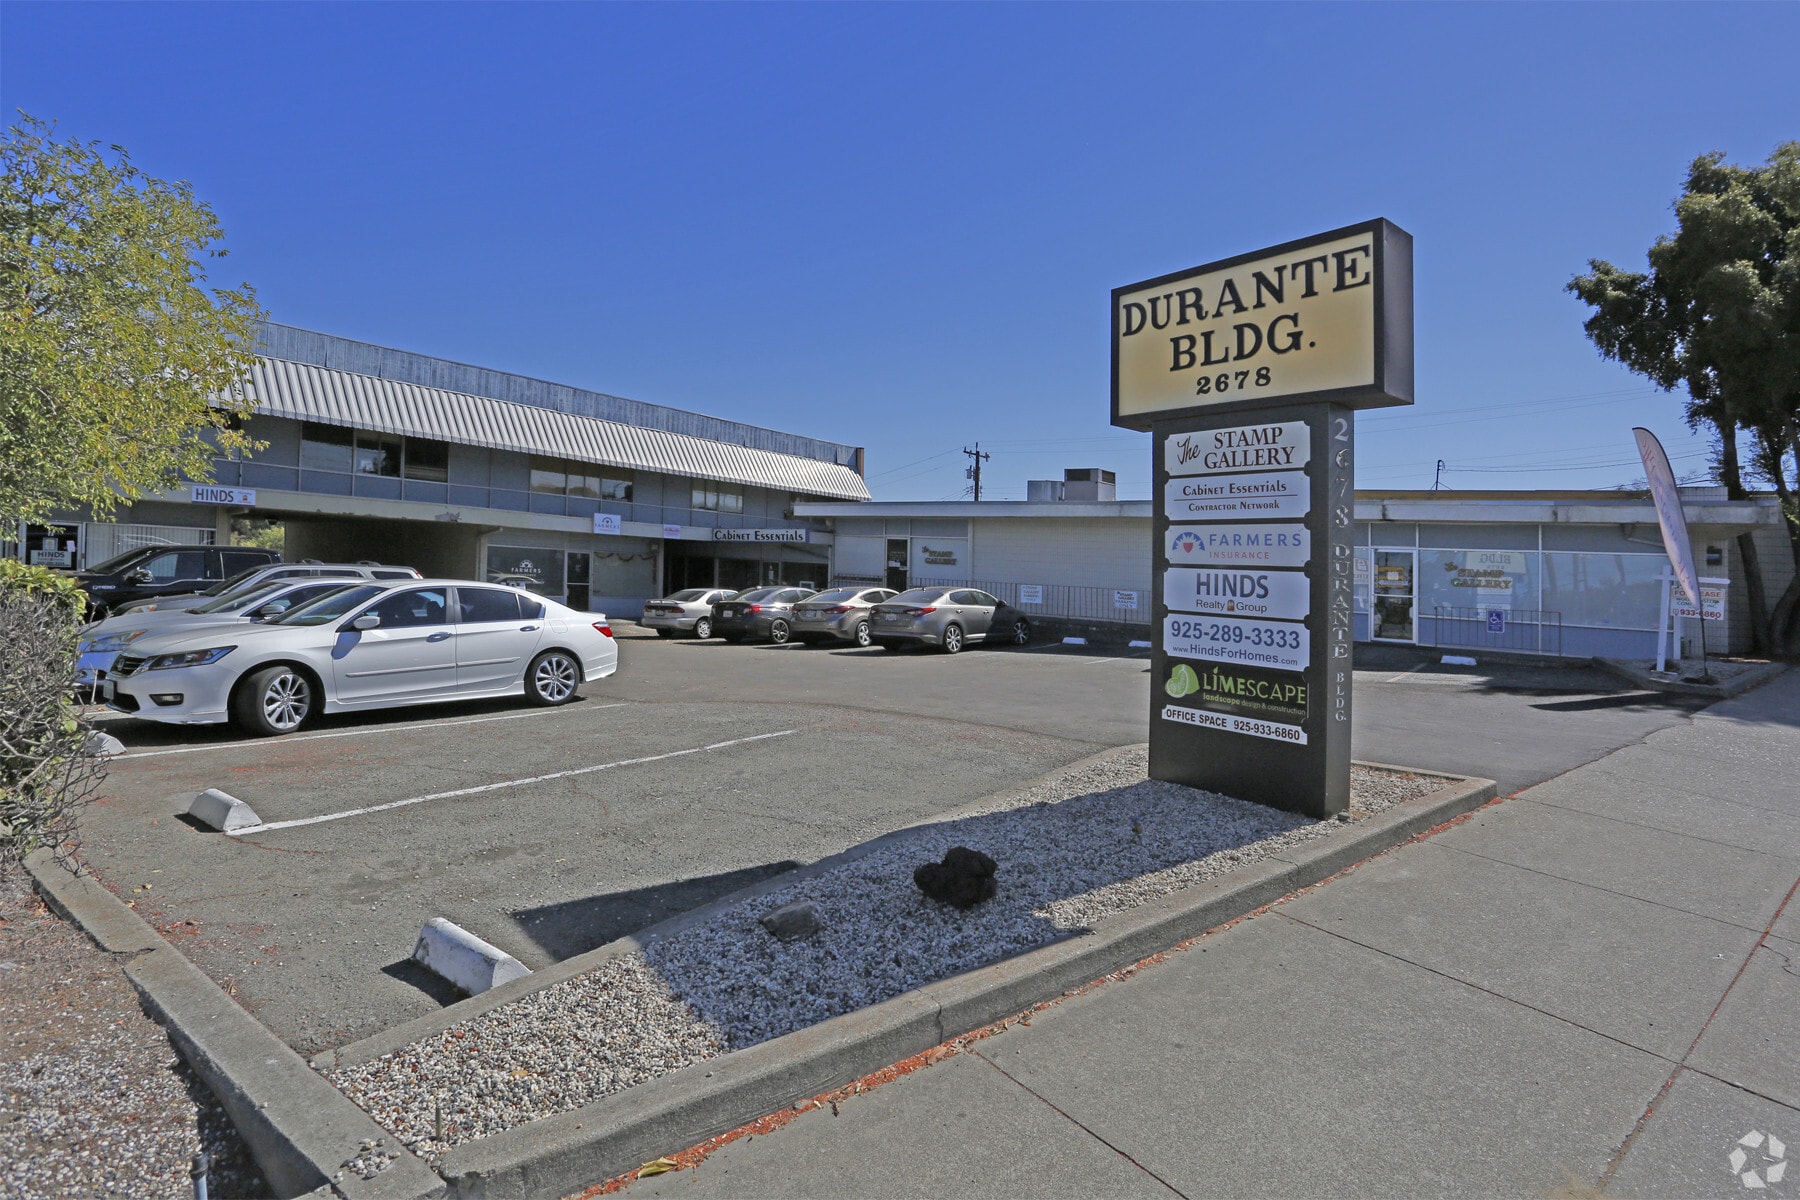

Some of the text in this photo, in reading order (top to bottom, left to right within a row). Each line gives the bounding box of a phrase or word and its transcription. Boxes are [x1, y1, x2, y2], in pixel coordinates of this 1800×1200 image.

[1122, 244, 1371, 338] DURANTE
[1169, 312, 1316, 372] BLDG.
[1196, 366, 1272, 395] 2678
[1214, 426, 1283, 449] STAMP
[1177, 435, 1201, 465] The
[1204, 446, 1296, 469] GALLERY
[195, 488, 234, 502] HINDS
[1209, 533, 1302, 547] FARMERS
[1209, 551, 1270, 559] INSURANCE
[1451, 578, 1513, 589] GALLERY
[1458, 569, 1505, 578] STAMP
[1196, 573, 1269, 599] HINDS
[1196, 599, 1267, 614] Realty Group
[1332, 544, 1350, 659] DURANTE
[1171, 620, 1300, 649] 925-289-3333
[1173, 644, 1298, 666] www.HindsForHomes.com
[1203, 693, 1241, 706] landscape
[1241, 699, 1260, 710] design
[1267, 704, 1306, 715] construction
[1166, 708, 1300, 741] OFFICE SPACE 925-933-6860
